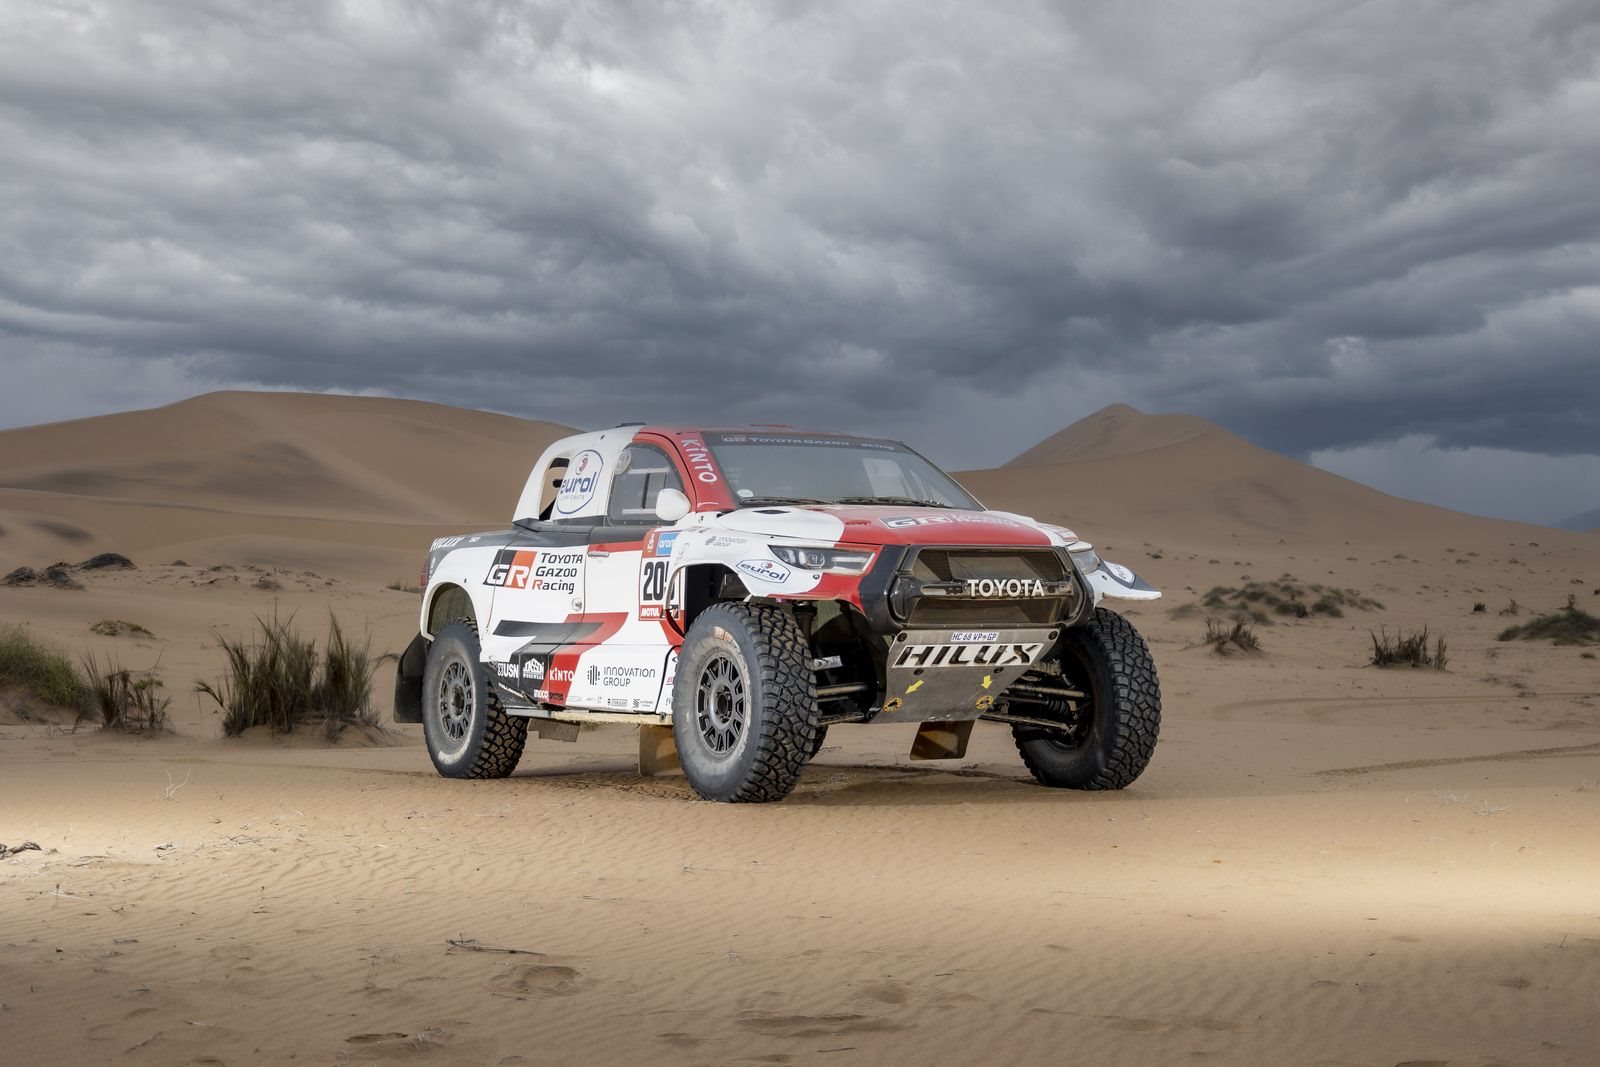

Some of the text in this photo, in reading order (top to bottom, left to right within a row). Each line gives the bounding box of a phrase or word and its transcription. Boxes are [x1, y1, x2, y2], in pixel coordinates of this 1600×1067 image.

[541, 552, 584, 564] TOYOTA
[486, 563, 530, 588] GR
[535, 566, 578, 578] GAZOO
[740, 563, 785, 581] eurol
[531, 579, 575, 595] Racing
[967, 579, 1046, 597] TOYOTA
[641, 607, 660, 617] MOTUL
[952, 633, 962, 641] HC
[963, 633, 972, 641] 68
[987, 633, 997, 641] GP
[894, 644, 1040, 666] HILUX
[503, 663, 519, 679] USN
[603, 666, 656, 678] INNOVATION
[603, 677, 631, 687] GROUP
